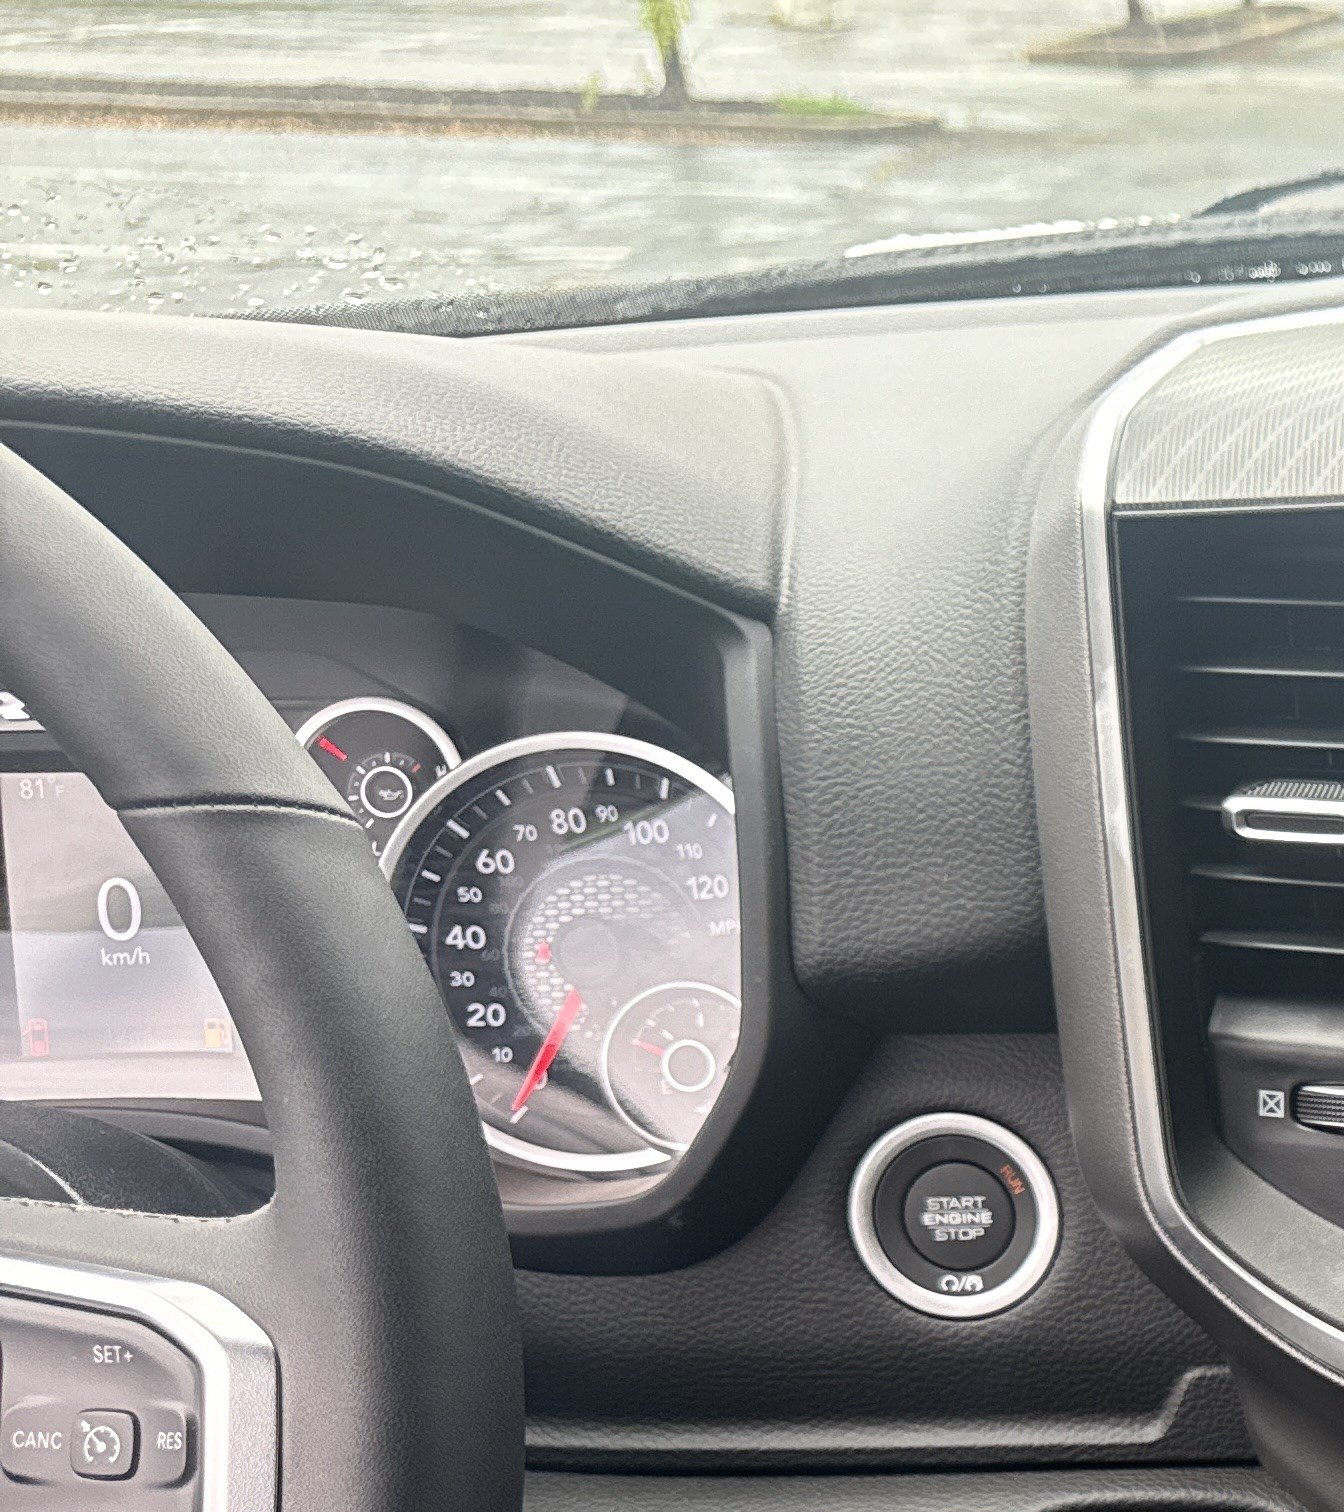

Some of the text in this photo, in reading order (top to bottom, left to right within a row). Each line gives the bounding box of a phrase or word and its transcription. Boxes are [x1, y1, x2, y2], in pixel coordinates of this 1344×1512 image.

[551, 807, 587, 834] 80
[595, 805, 618, 822] 90
[513, 824, 538, 841] 70
[624, 820, 669, 845] 100
[677, 842, 703, 859] 110
[475, 849, 515, 874] 60
[456, 886, 483, 904] 50
[686, 874, 730, 900] 120
[97, 878, 142, 941] 0
[708, 919, 737, 936] MP
[445, 924, 487, 950] 40
[100, 949, 150, 966] km/h
[449, 970, 475, 988] 30
[466, 1003, 506, 1028] 20
[492, 1046, 513, 1063] 10
[926, 1197, 986, 1210] START
[923, 1212, 993, 1226] ENGINE
[934, 1227, 985, 1241] STOP
[12, 1431, 63, 1450] CANC
[157, 1431, 182, 1450] RES
